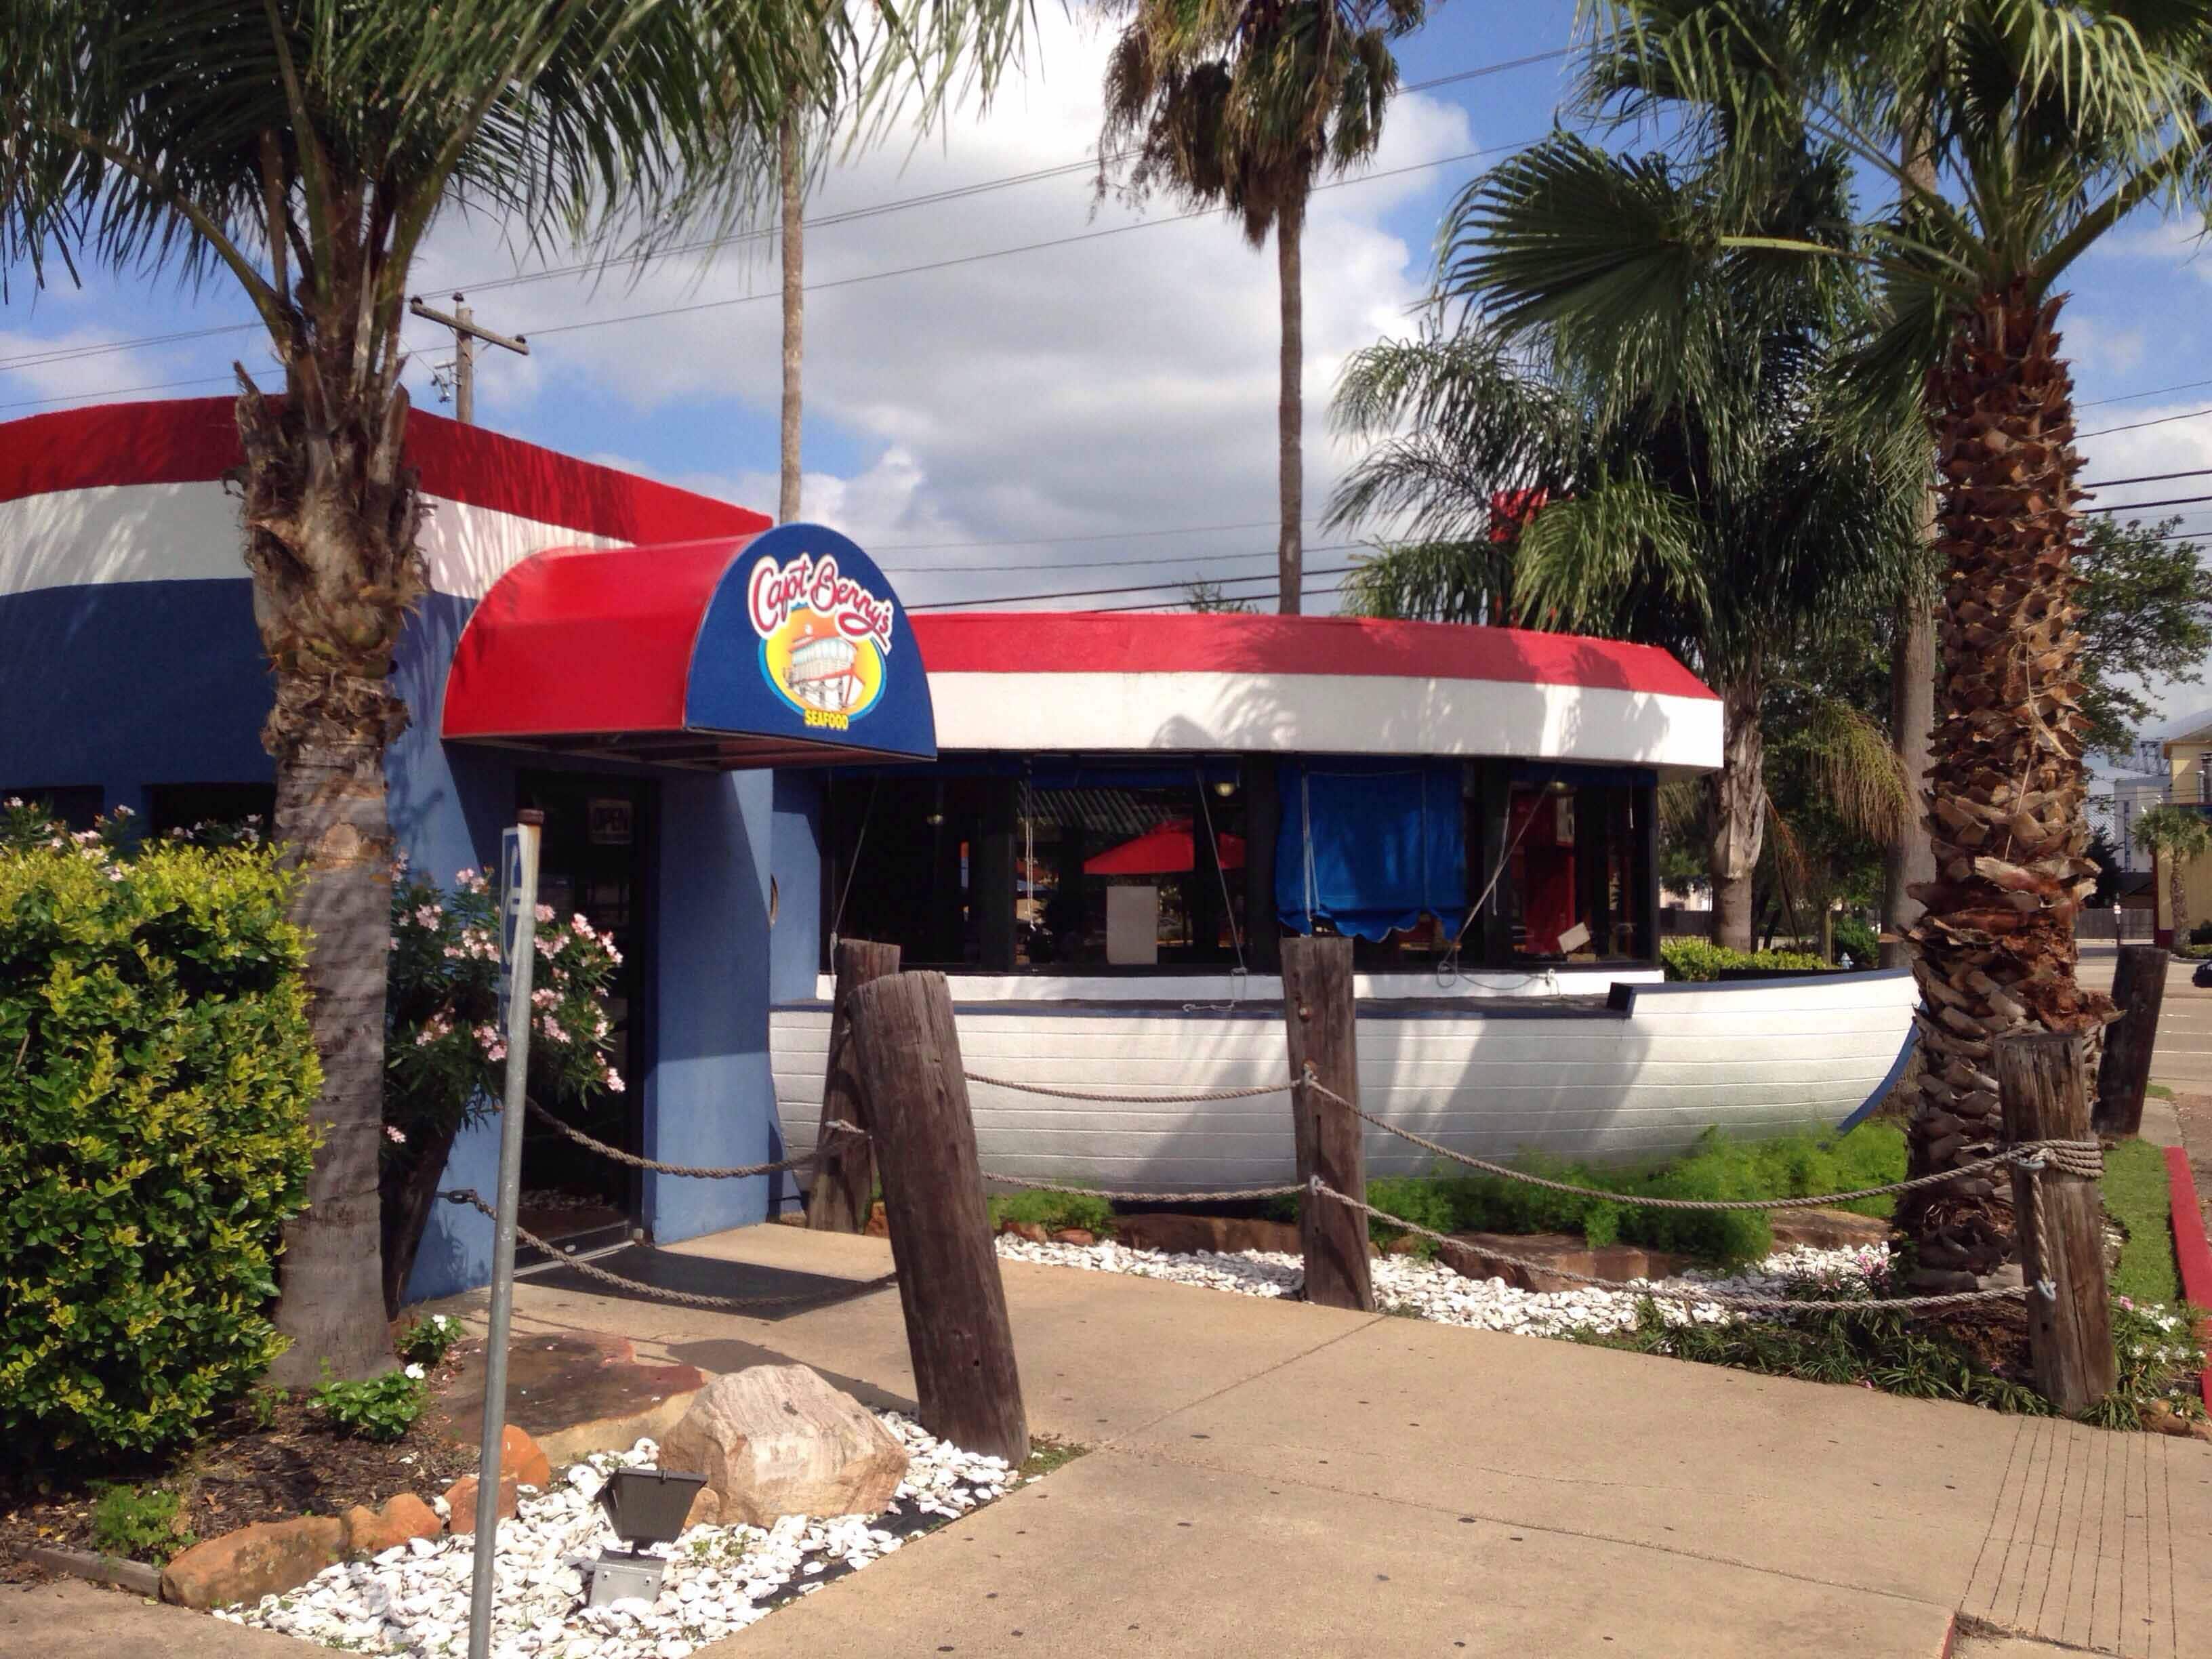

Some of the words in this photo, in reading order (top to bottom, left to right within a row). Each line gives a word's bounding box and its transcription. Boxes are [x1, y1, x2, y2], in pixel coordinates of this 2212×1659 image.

[751, 557, 808, 634] Capt
[810, 558, 891, 650] Benny's
[804, 709, 848, 730] SEAFOOD
